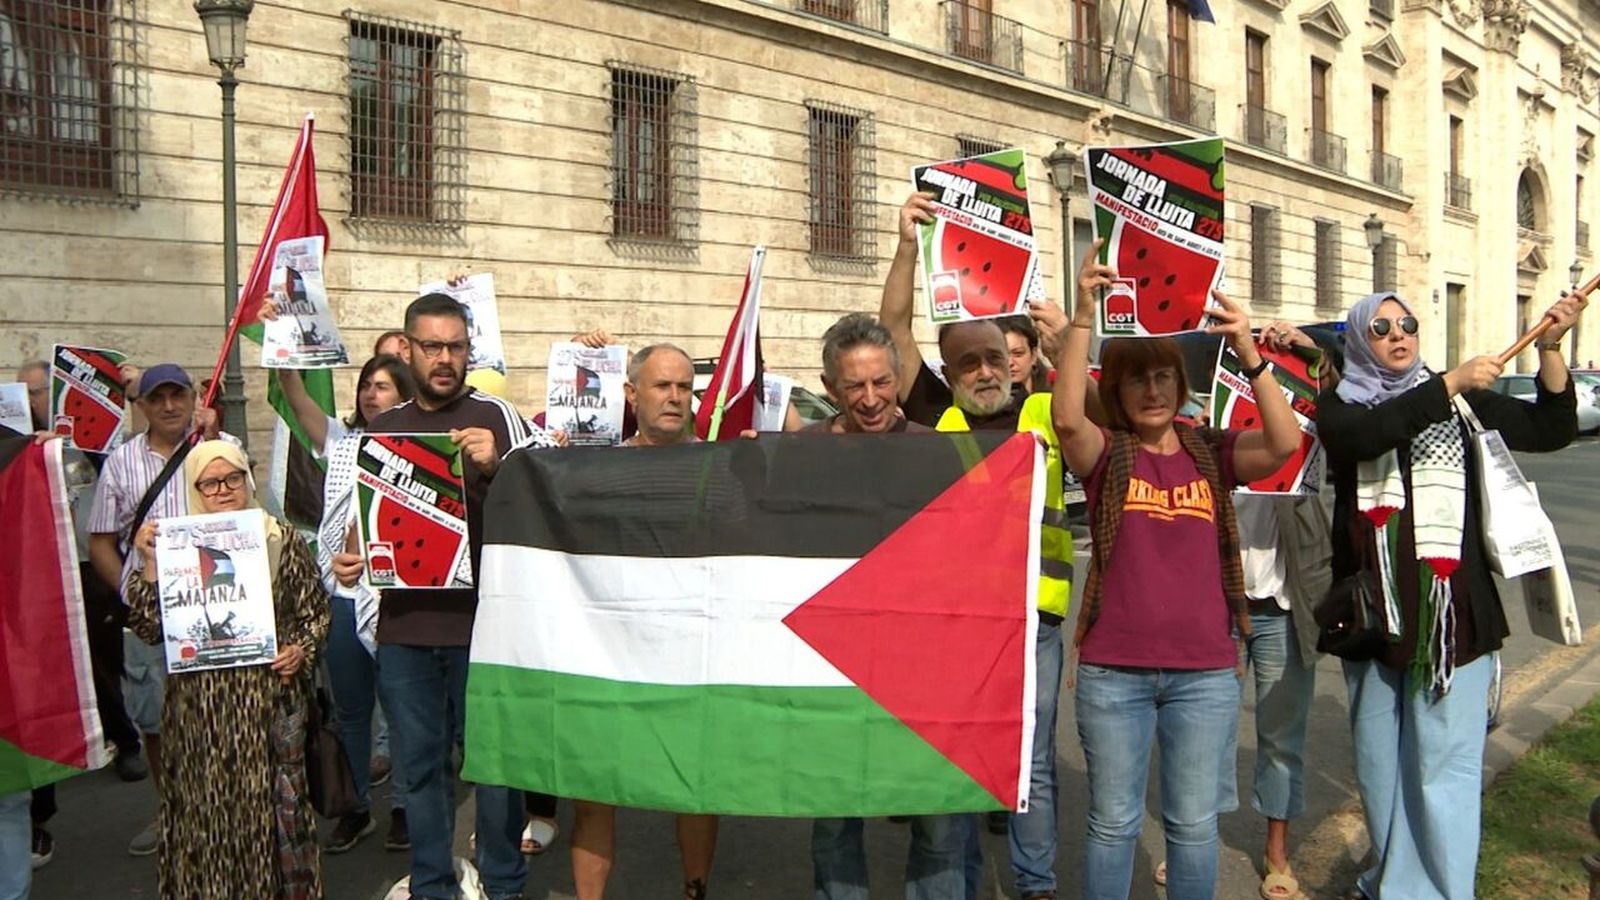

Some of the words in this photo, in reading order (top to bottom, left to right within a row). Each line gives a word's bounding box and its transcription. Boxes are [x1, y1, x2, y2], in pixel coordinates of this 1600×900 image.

[1096, 152, 1167, 198] JORNADA
[941, 187, 961, 207] DE
[960, 194, 1002, 223] LLUITA
[1122, 184, 1146, 207] DE
[1145, 194, 1196, 230] LLUITA
[1108, 312, 1133, 323] CGT
[379, 463, 398, 484] DE
[397, 474, 438, 505] LLUITA
